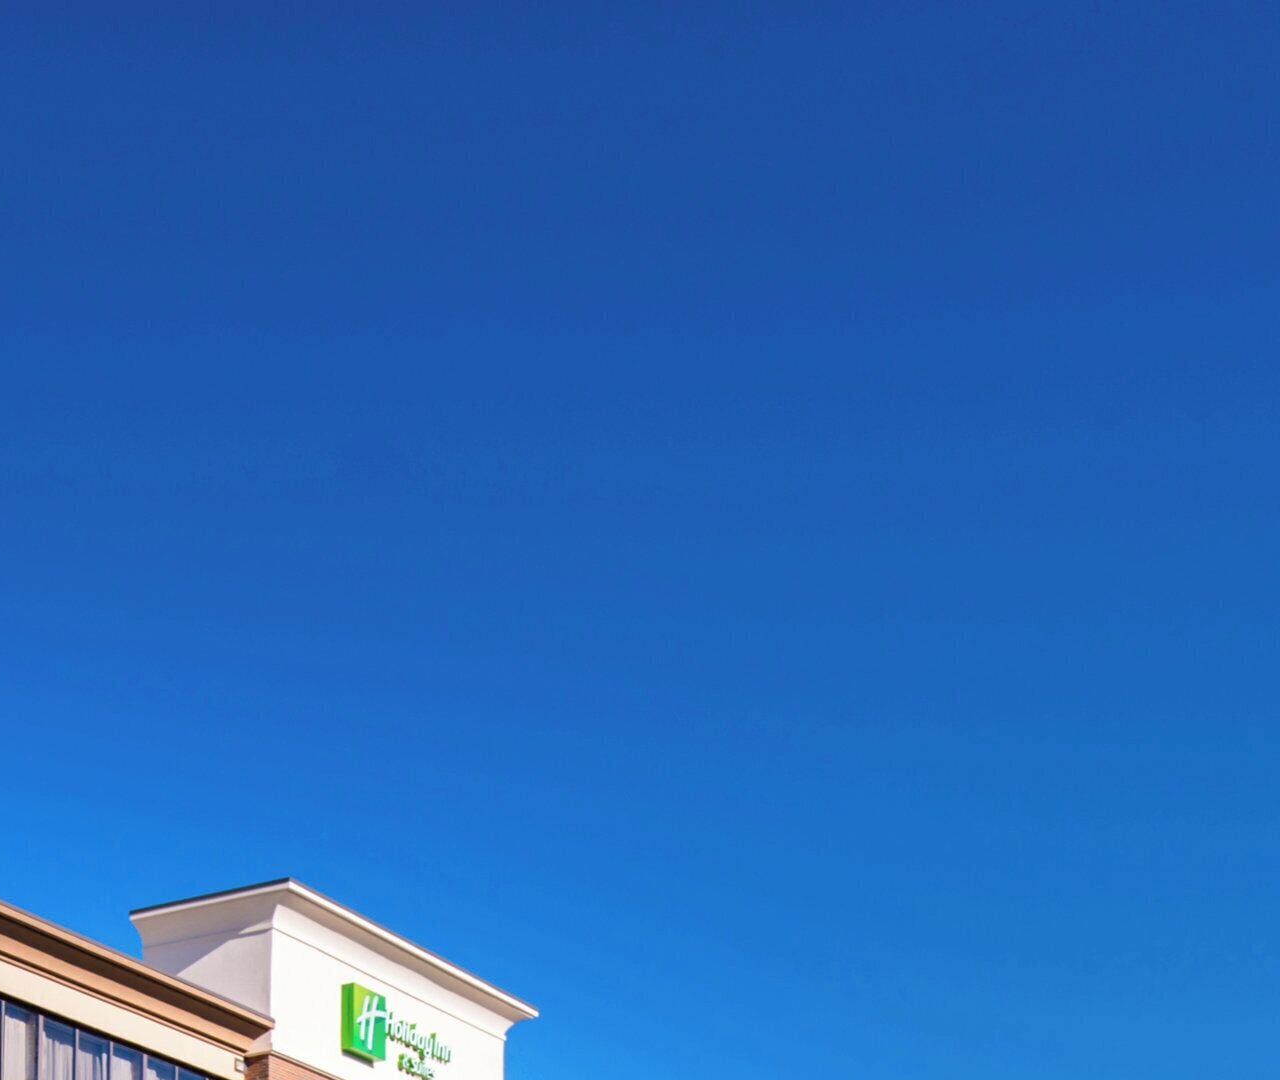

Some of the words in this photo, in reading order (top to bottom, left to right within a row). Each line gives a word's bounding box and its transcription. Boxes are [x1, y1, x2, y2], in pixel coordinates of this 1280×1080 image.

[356, 994, 387, 1051] H
[385, 1011, 431, 1058] Holiday
[432, 1033, 451, 1063] Inn
